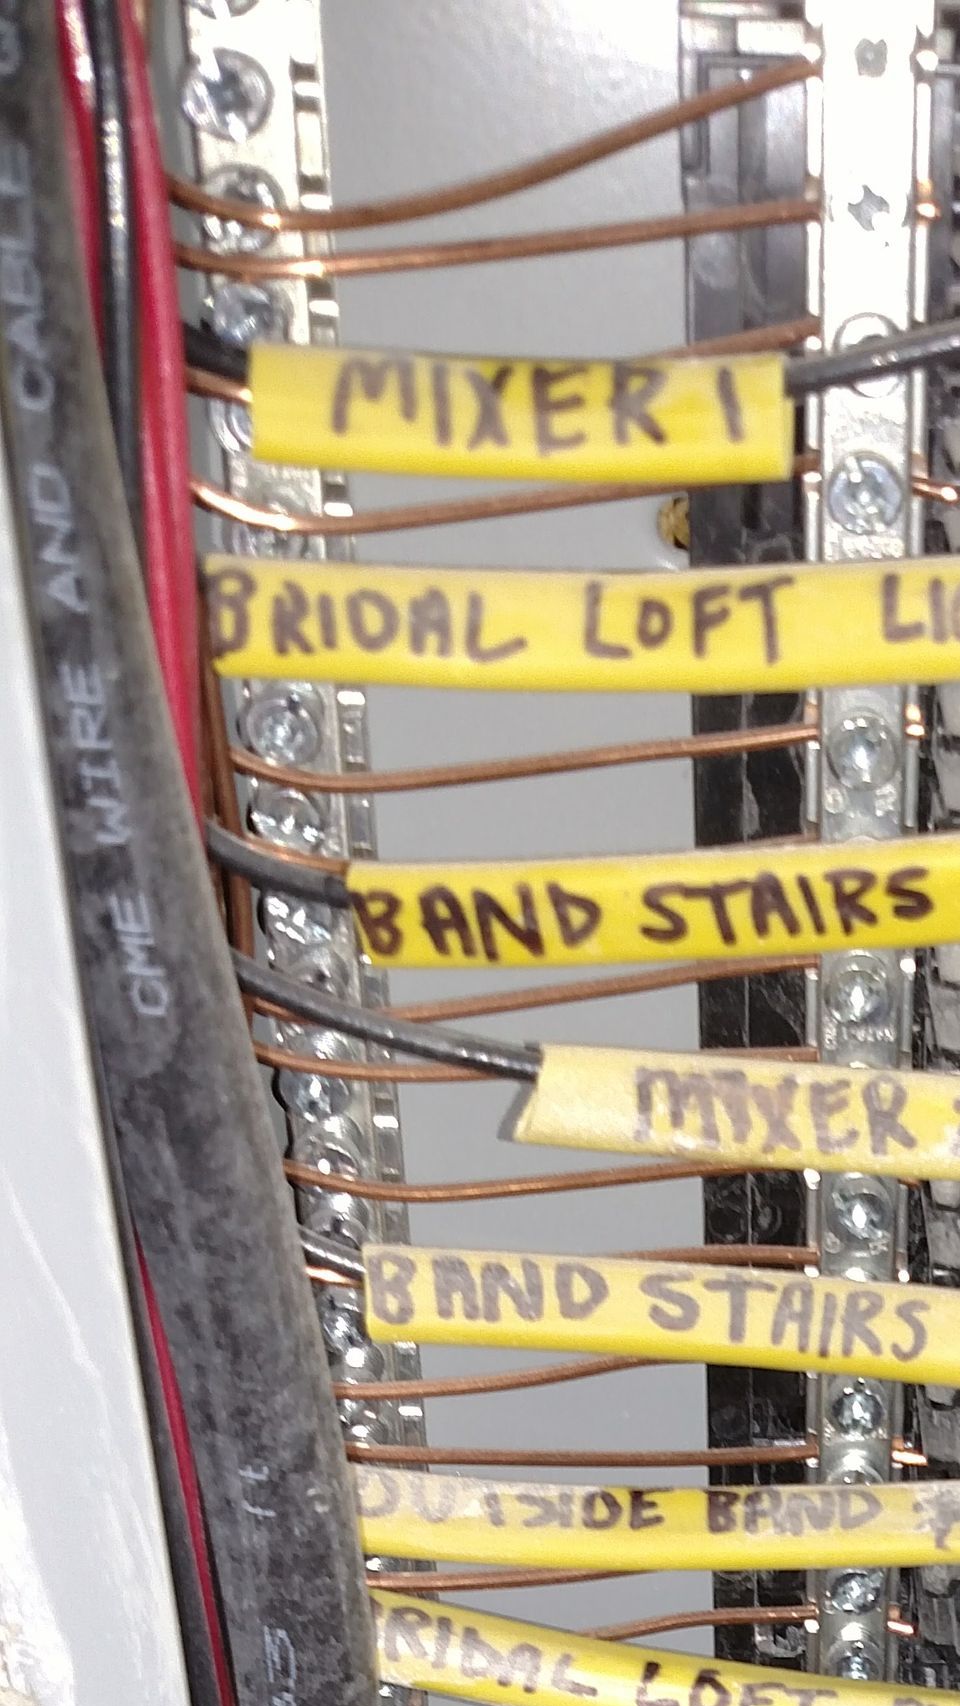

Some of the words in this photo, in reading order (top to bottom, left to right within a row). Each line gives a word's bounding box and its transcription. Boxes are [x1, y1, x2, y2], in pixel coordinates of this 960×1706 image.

[332, 355, 668, 455] MIXER
[719, 368, 744, 443] 1
[29, 464, 90, 614] AND
[208, 566, 528, 662] BRIDAL
[585, 577, 795, 664] LOFT
[58, 660, 133, 848] WIRE
[107, 888, 171, 1020] CME
[349, 884, 602, 961] BAND
[641, 867, 933, 947] STAIRS
[634, 1065, 918, 1155] MIXER
[367, 1251, 609, 1325] BAND
[640, 1270, 932, 1362] STAIRS
[706, 1485, 882, 1537] BAND
[373, 1597, 598, 1698] RIDAL
